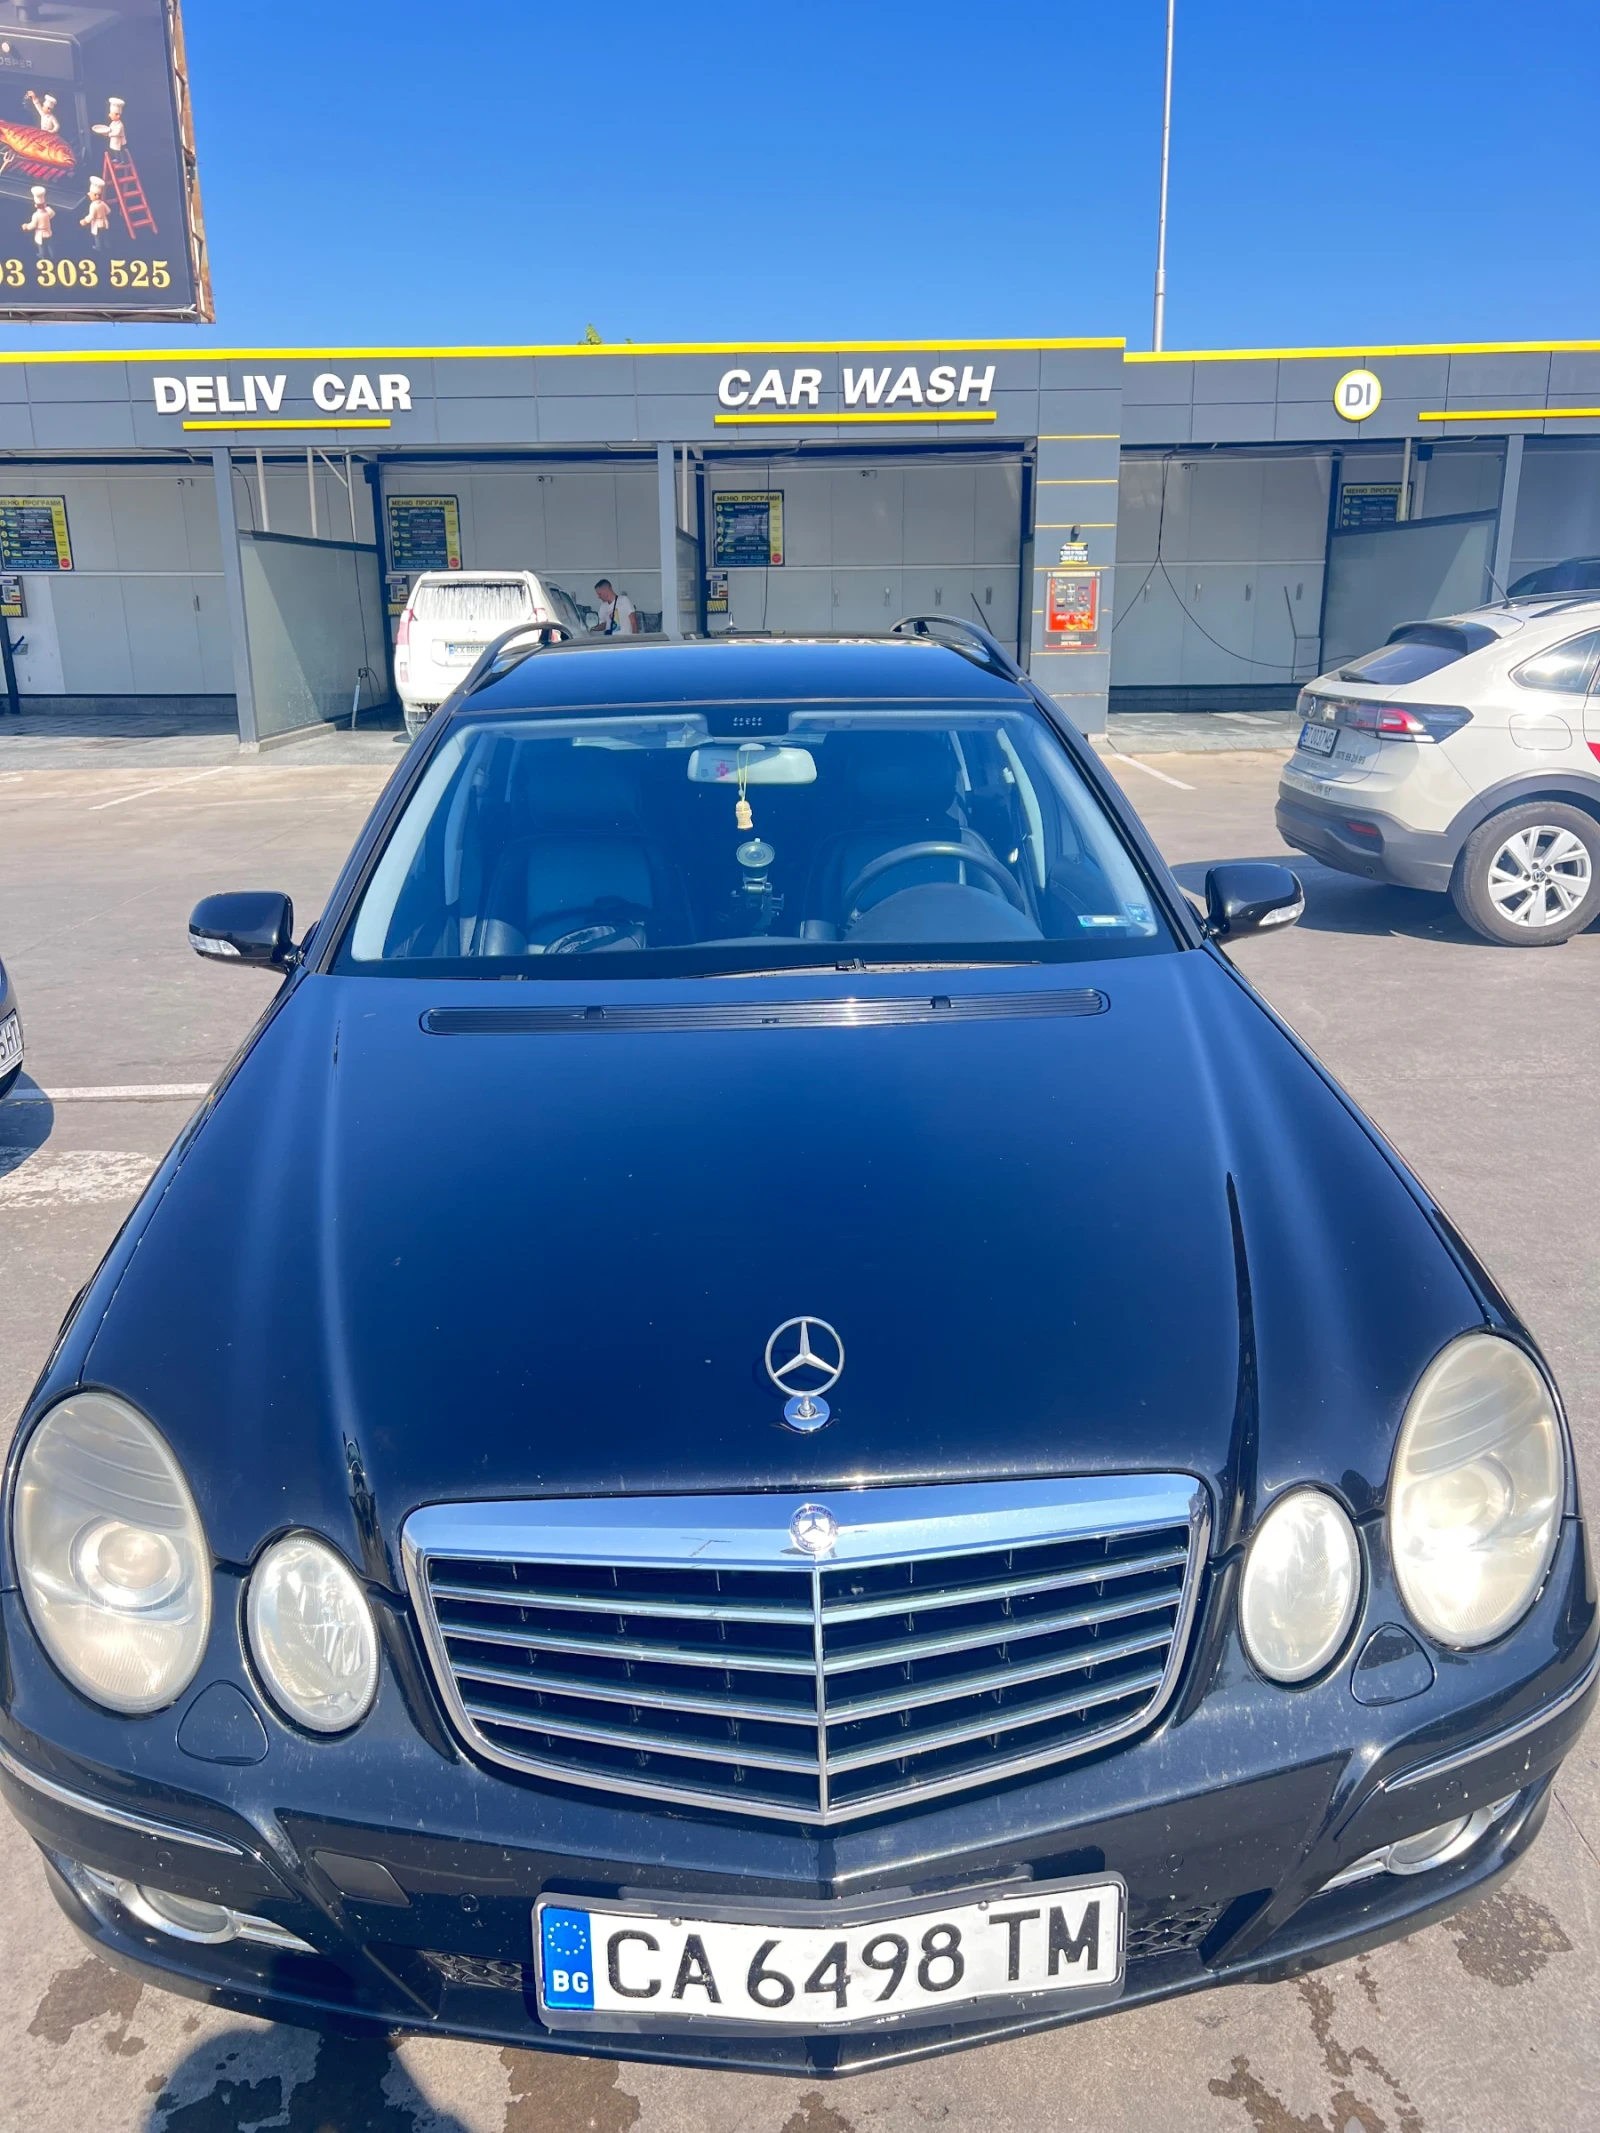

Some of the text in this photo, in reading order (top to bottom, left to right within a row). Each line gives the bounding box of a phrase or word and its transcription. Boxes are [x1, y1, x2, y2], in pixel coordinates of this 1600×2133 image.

[0, 258, 171, 288] 3 303 525
[153, 373, 413, 415] DELIV CAR
[718, 365, 997, 407] CAR WASH
[1345, 383, 1372, 407] DI
[553, 1900, 1100, 2009] BG CA 6498 TM
